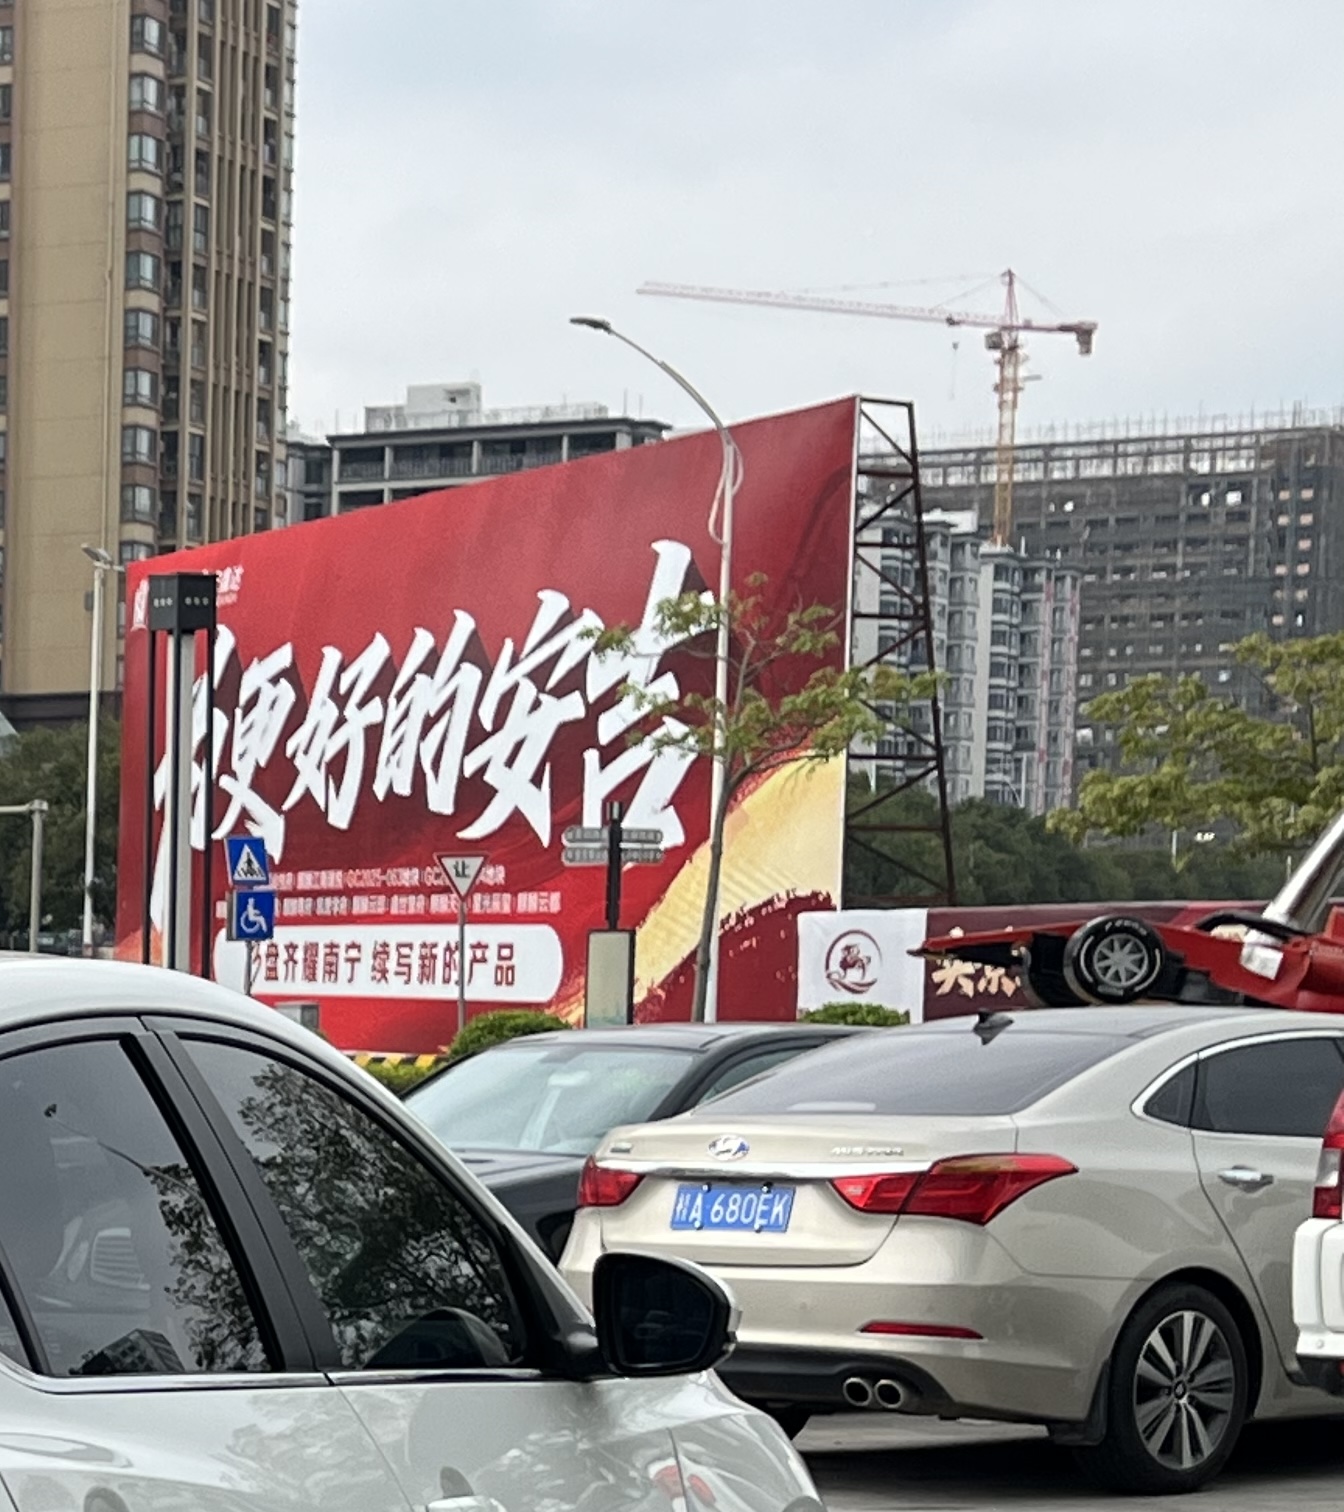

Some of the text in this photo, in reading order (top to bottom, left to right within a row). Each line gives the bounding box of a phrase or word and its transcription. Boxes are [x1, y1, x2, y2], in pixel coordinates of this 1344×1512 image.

[453, 860, 470, 878] 让
[370, 940, 516, 987] 续写新的产品
